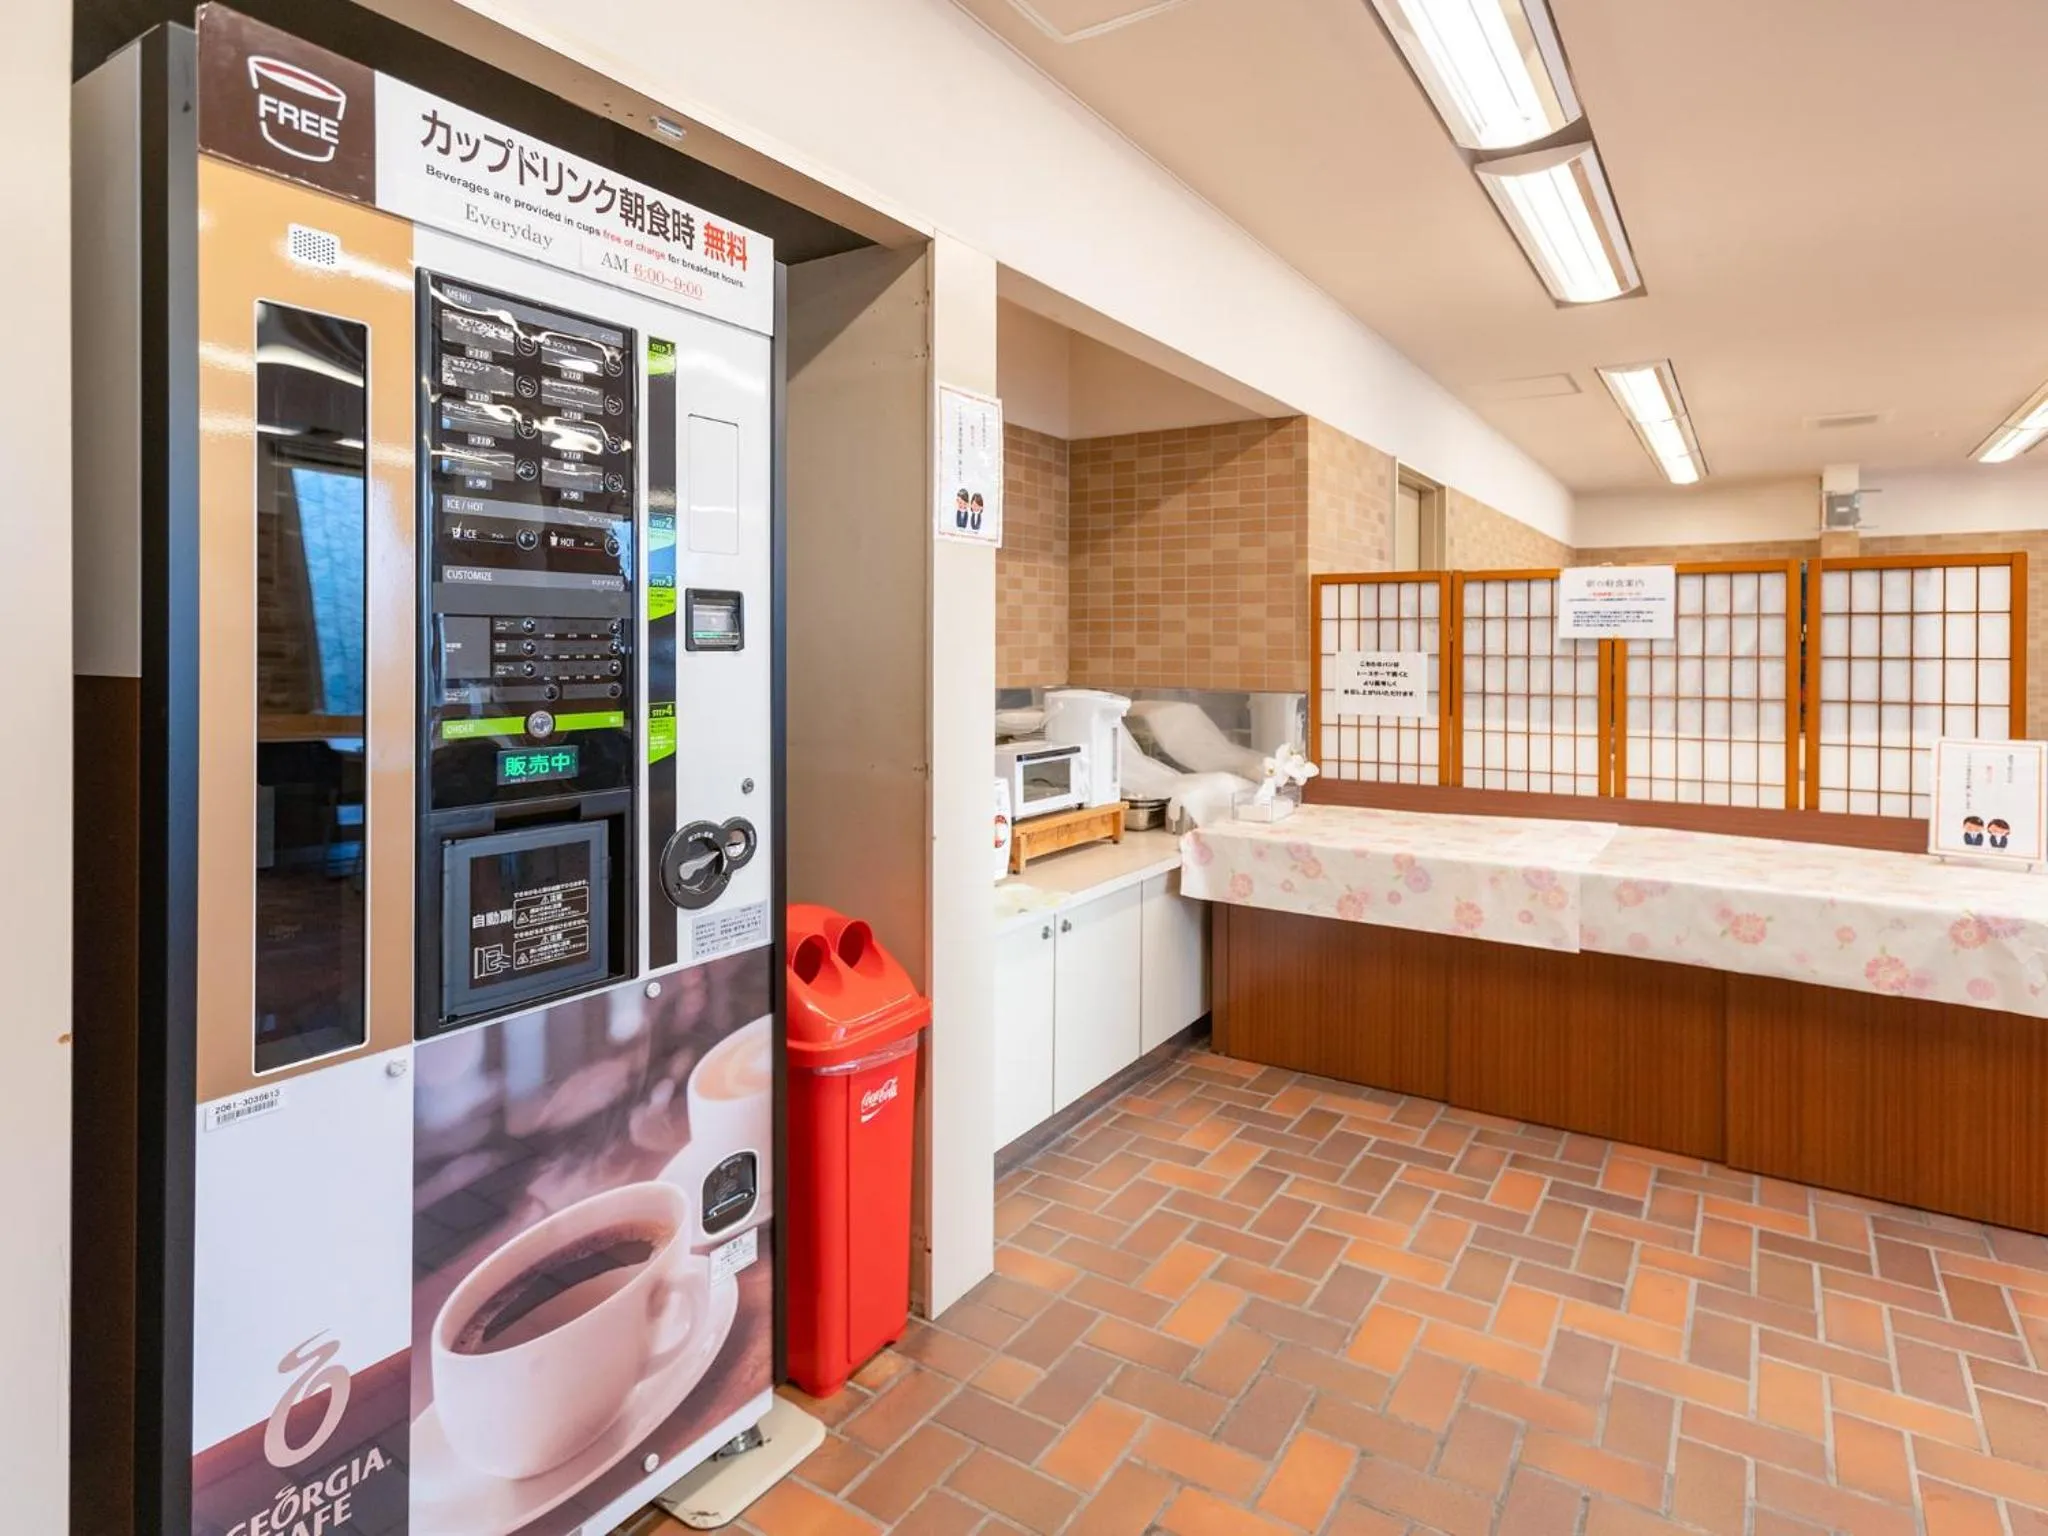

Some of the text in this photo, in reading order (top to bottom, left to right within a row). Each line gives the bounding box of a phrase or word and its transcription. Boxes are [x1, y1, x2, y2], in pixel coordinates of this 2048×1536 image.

[259, 93, 340, 145] FREE
[420, 109, 748, 272] カップドリンク朝食時 無料
[425, 163, 747, 289] Beverages are provided in cups free of charge for breakfast hours.
[464, 202, 554, 250] Everyday
[601, 251, 629, 274] AM
[446, 288, 473, 304] MENU
[446, 499, 461, 511] ICE
[467, 501, 484, 512] HOT
[463, 529, 477, 539] ICE
[559, 538, 575, 547] HOT
[446, 570, 493, 582] CUSTOMIZE
[504, 752, 571, 777] 販売中
